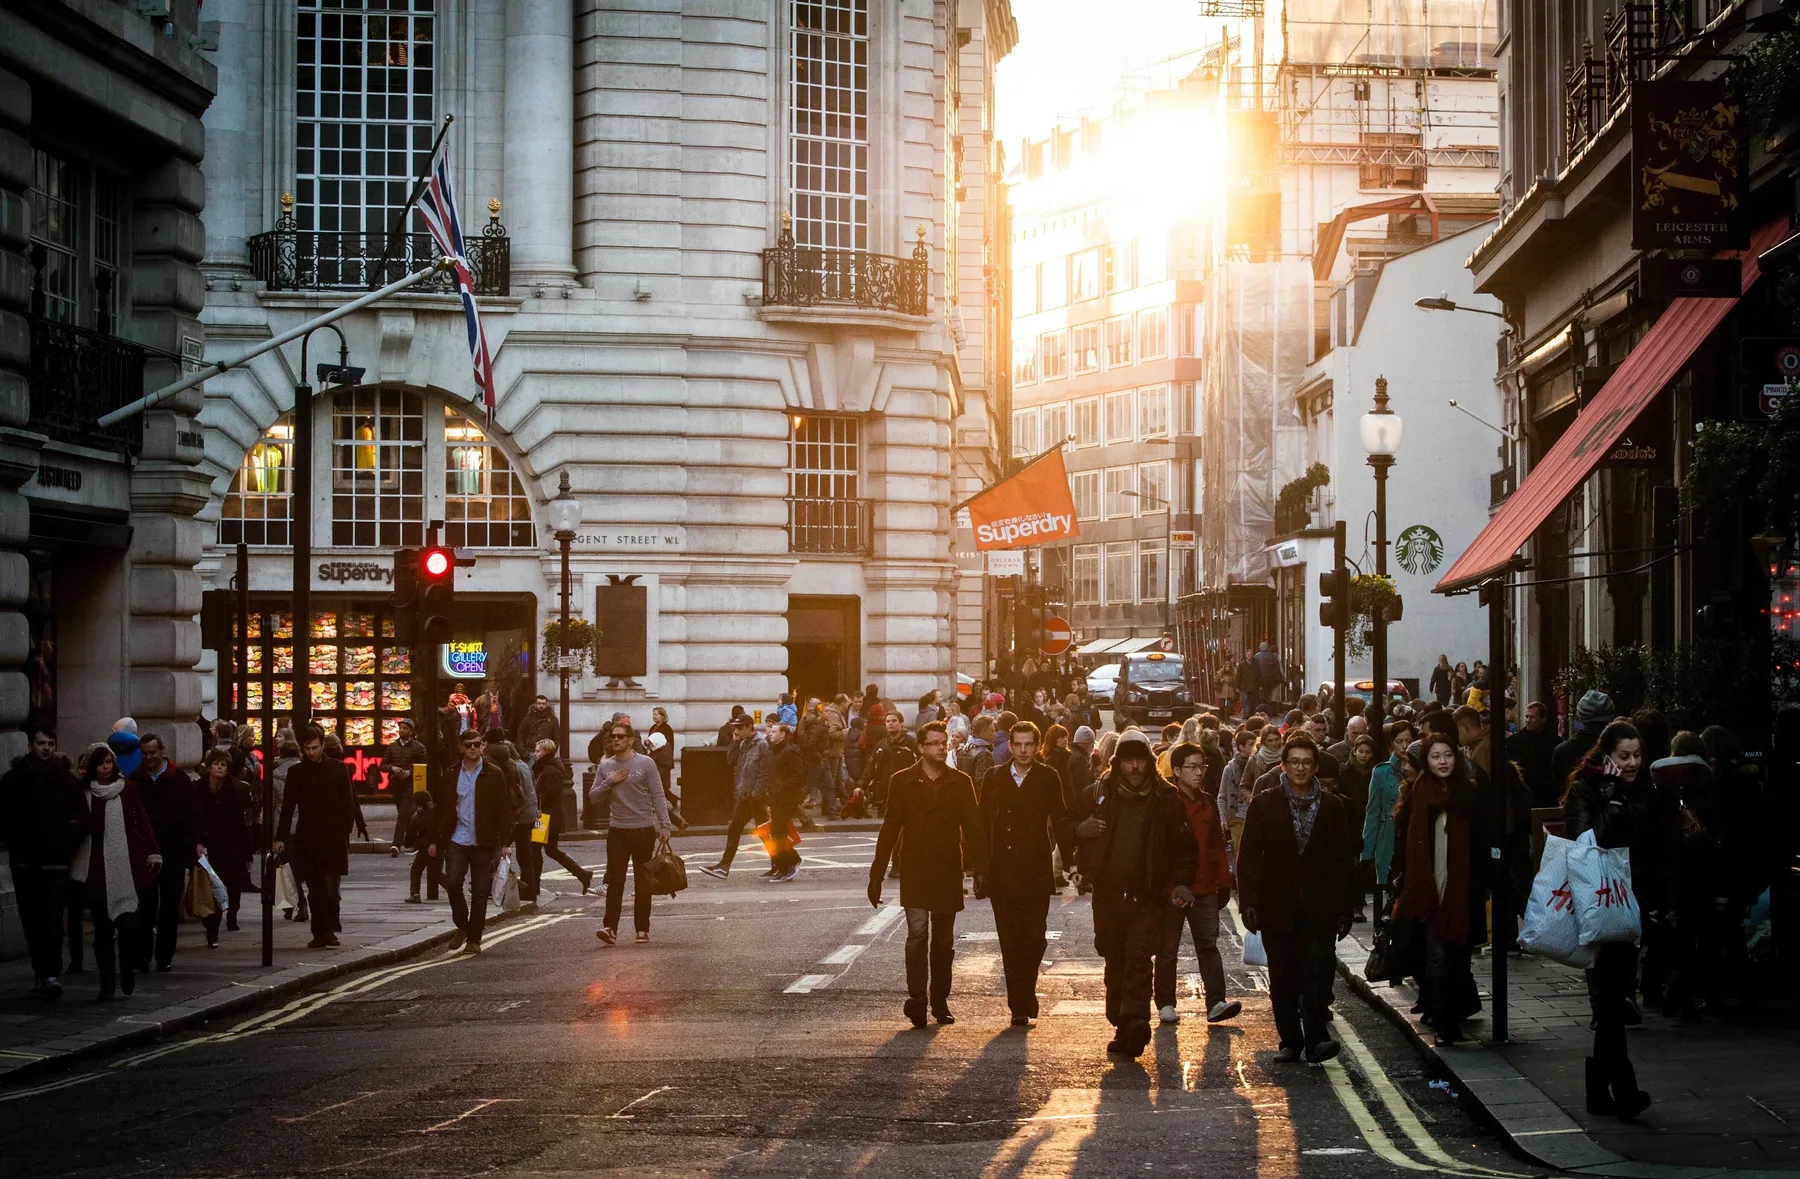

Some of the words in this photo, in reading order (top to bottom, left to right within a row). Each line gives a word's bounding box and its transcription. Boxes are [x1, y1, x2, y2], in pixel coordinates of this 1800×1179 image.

[1656, 222, 1728, 232] LEICESTER
[1673, 235, 1712, 244] ARMS
[1766, 386, 1788, 394] PROUD
[977, 513, 1072, 544] Superdry
[617, 536, 657, 544] STREET
[319, 563, 396, 585] Superdry
[450, 642, 484, 653] T-SHIRT
[452, 652, 488, 663] GALLERY
[1595, 876, 1631, 910] H&M
